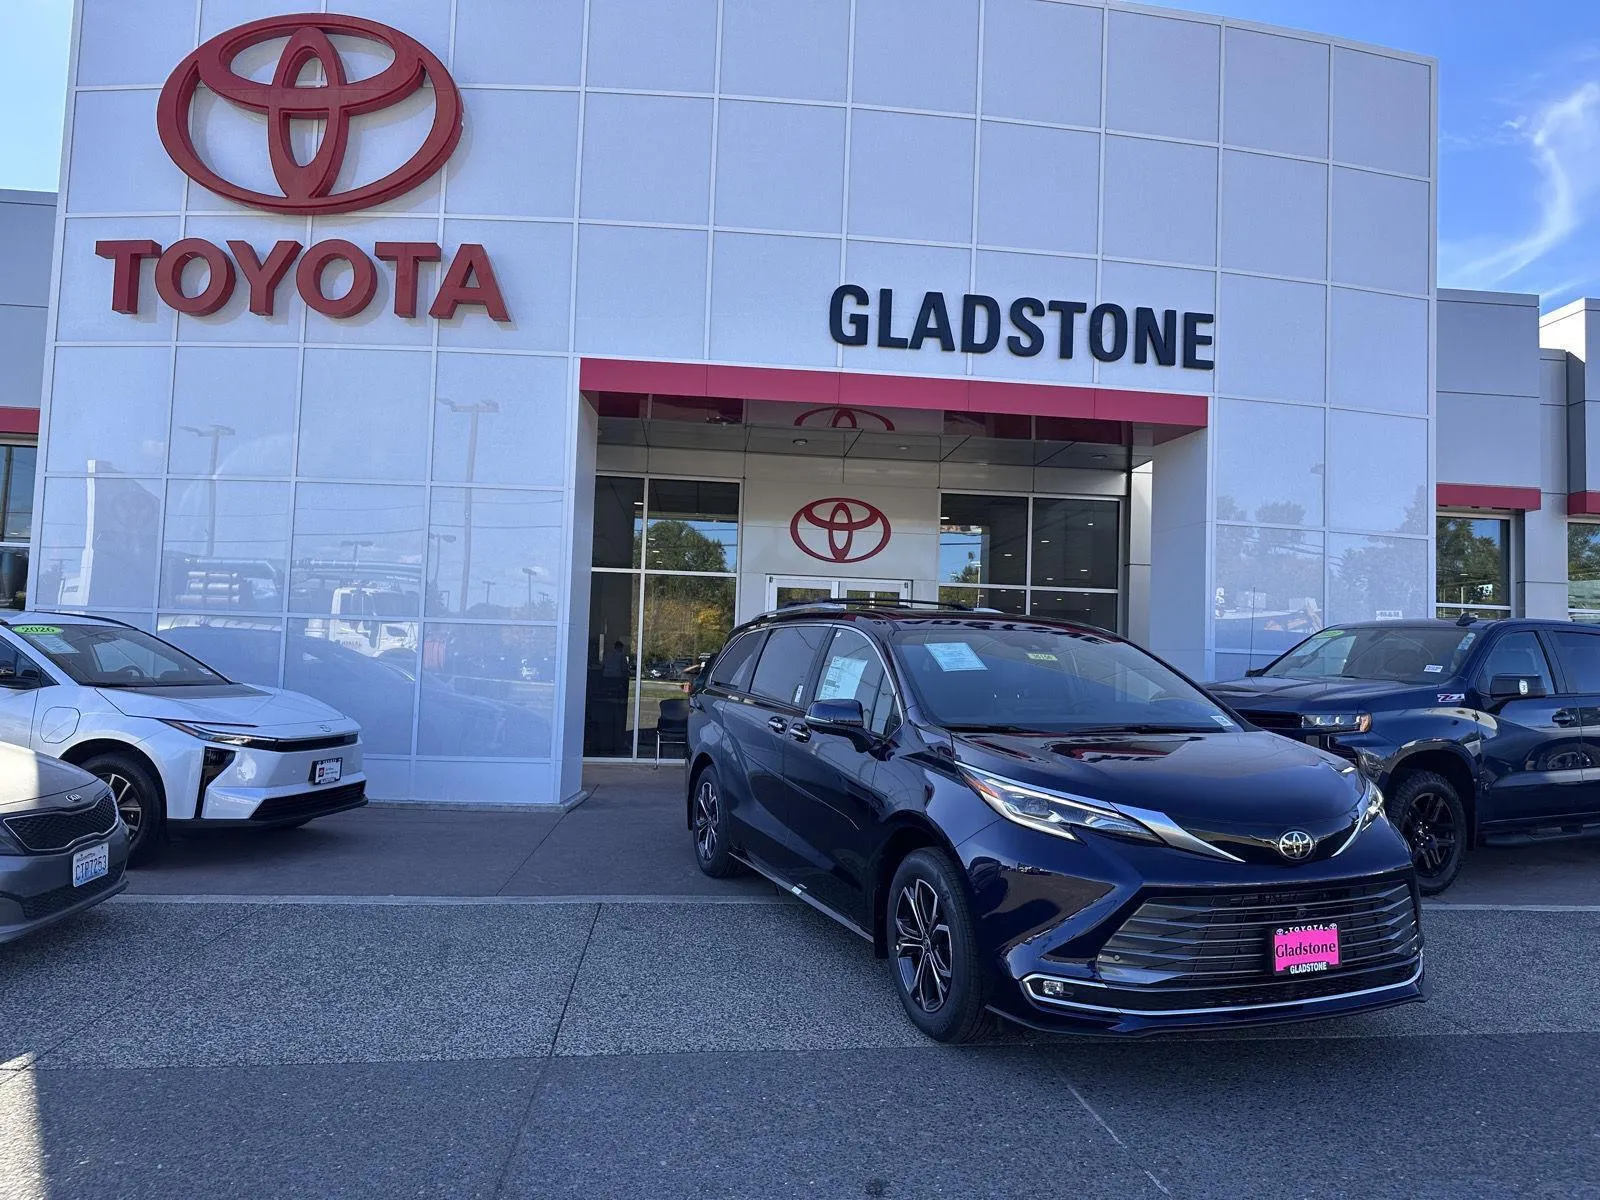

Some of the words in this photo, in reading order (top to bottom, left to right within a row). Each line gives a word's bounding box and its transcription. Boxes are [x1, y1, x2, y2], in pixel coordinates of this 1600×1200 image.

[95, 237, 512, 322] TOYOTA
[829, 284, 1214, 370] GLADSTONE
[1289, 924, 1324, 932] TOYOTA
[1276, 942, 1336, 957] Gladstone
[1290, 962, 1327, 974] GLADSTONE
